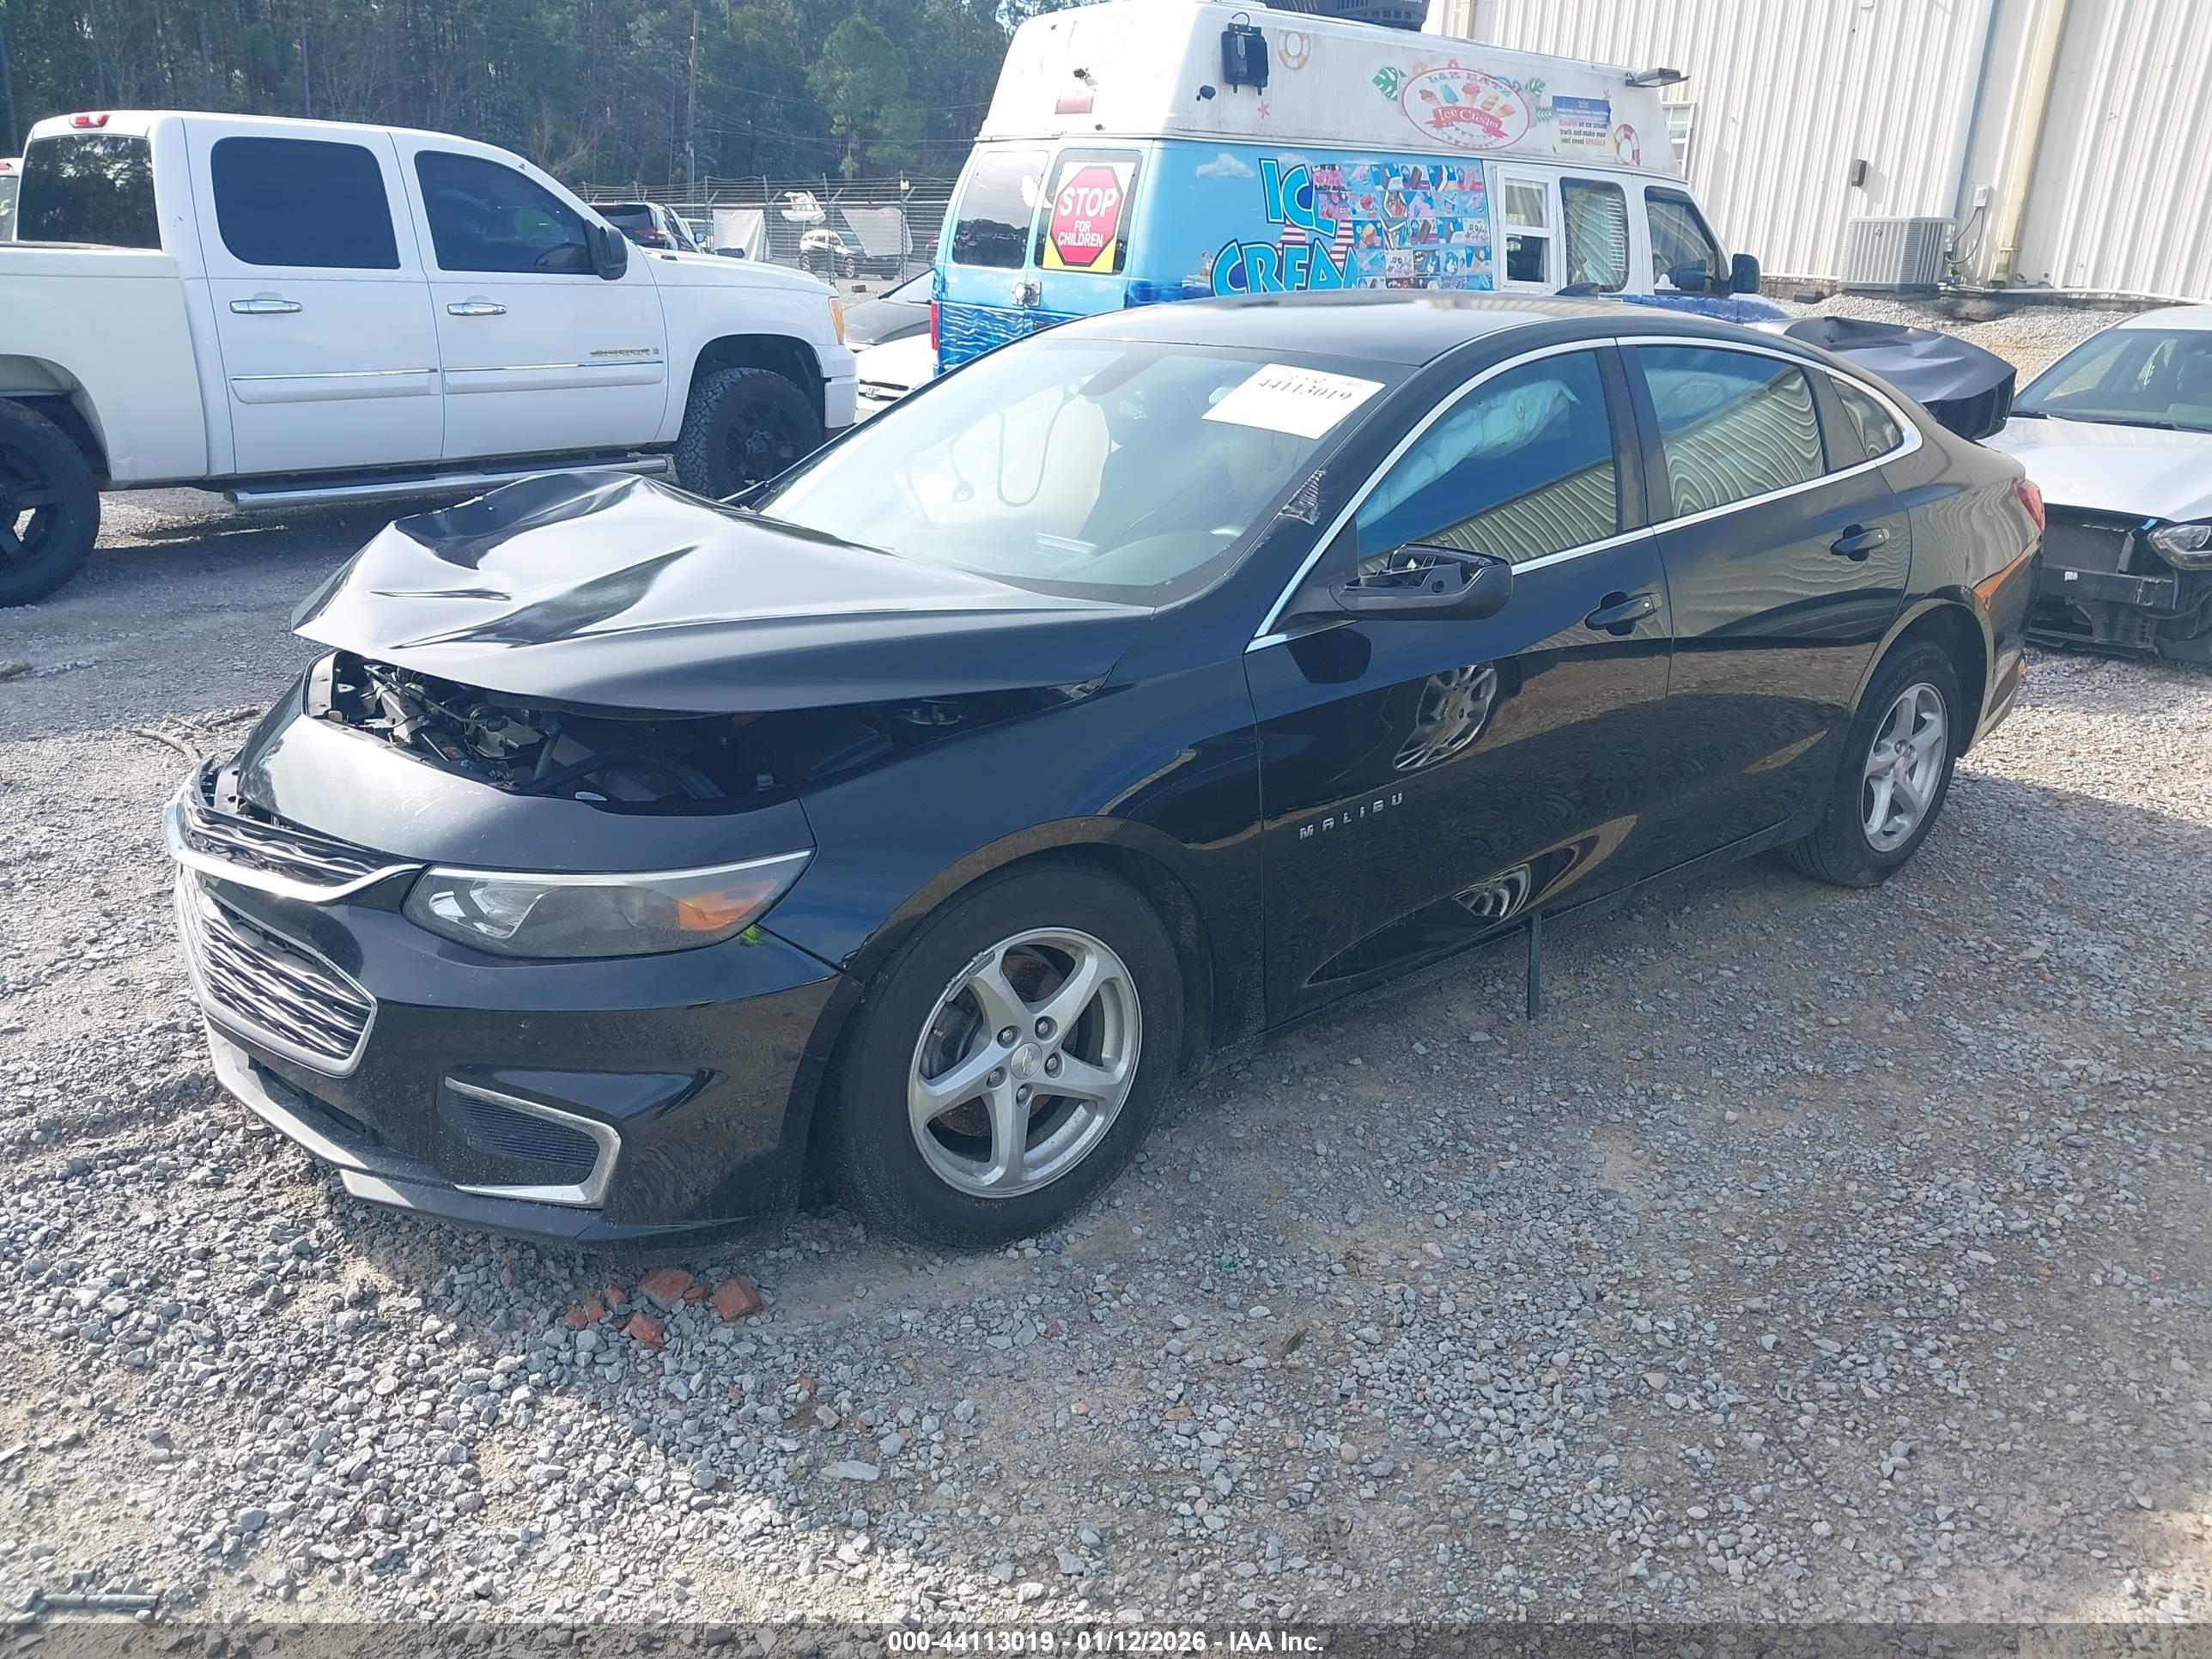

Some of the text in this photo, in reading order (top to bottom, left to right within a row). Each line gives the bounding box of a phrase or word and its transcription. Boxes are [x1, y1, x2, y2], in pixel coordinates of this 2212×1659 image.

[1437, 108, 1499, 129] Ice Cream
[1060, 187, 1118, 216] STOP
[1074, 220, 1091, 233] FOR
[1058, 232, 1103, 247] CHILDREN
[1299, 792, 1403, 840] MALIBU
